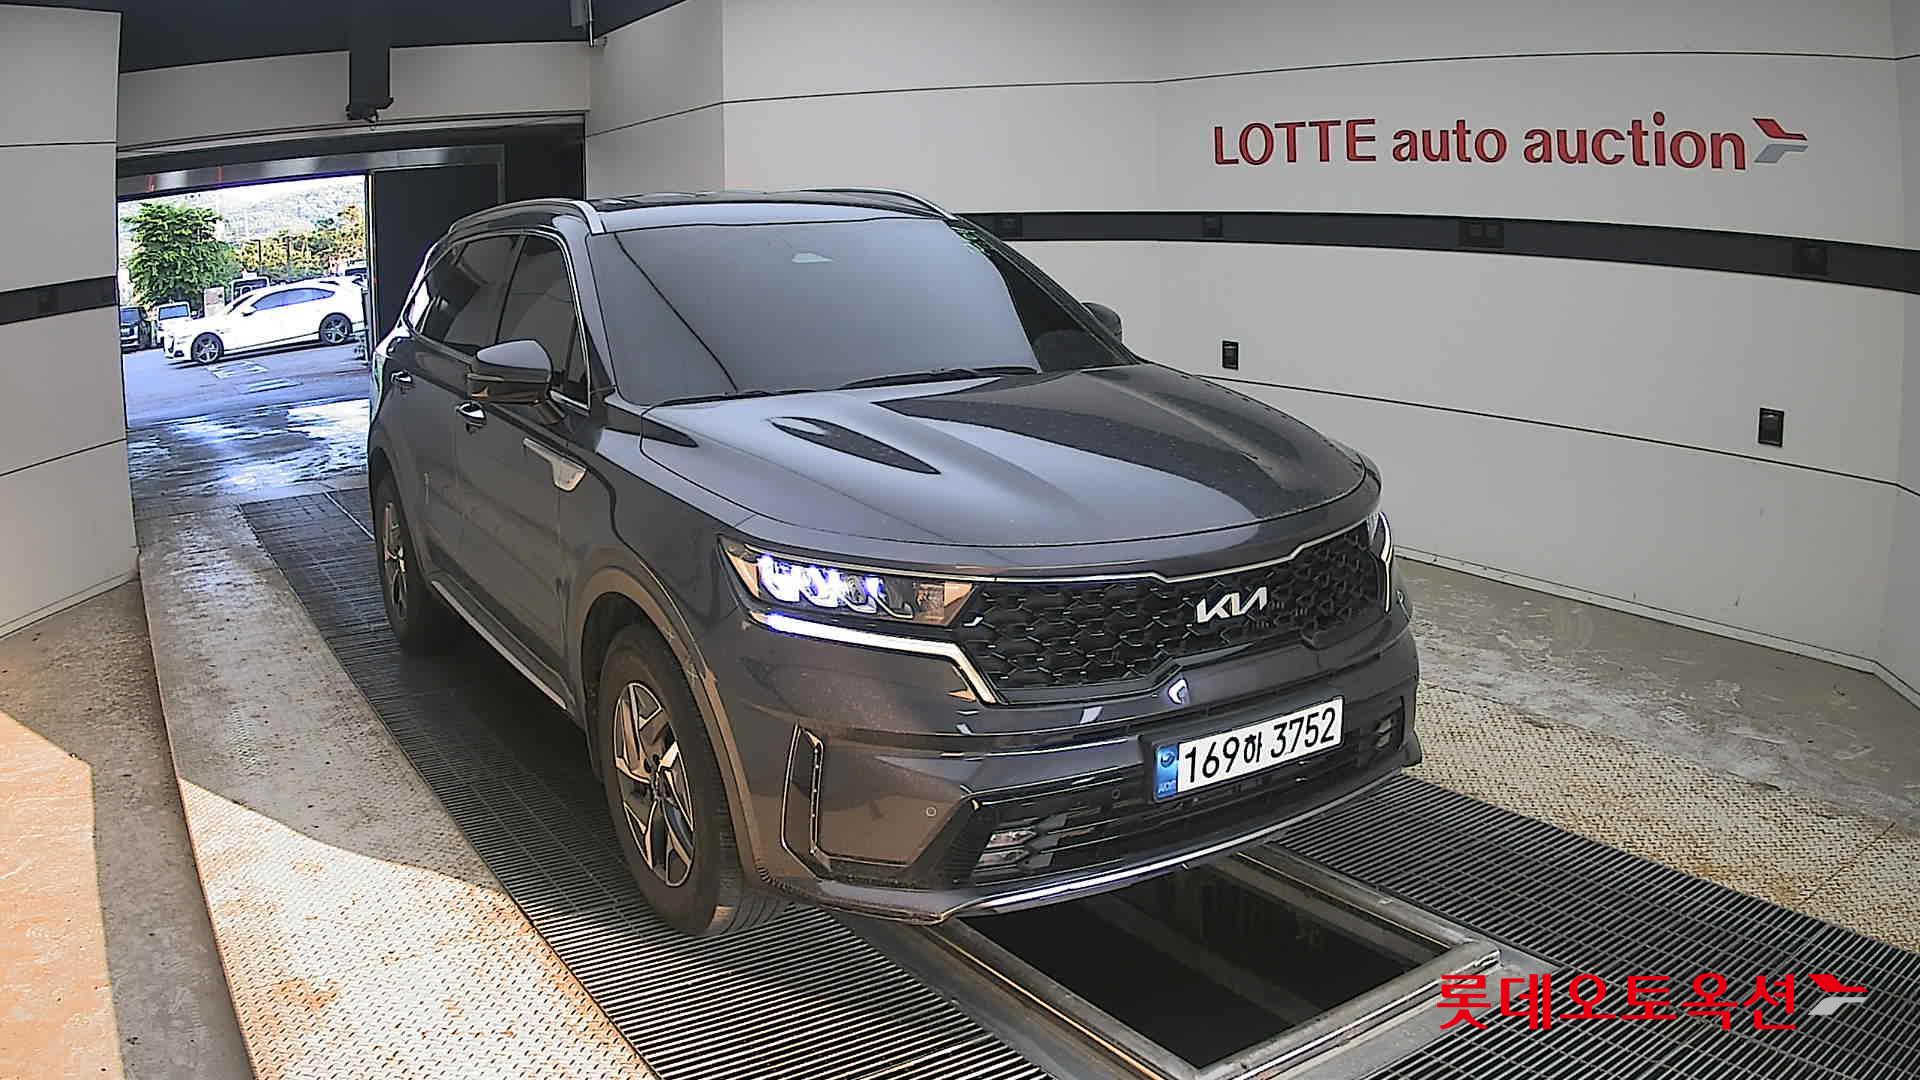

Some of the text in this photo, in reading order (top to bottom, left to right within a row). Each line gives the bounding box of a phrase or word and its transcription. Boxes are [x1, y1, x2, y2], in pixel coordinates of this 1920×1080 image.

[1214, 111, 1747, 170] LOTTE auto auction
[1196, 586, 1268, 623] KIA
[1185, 707, 1336, 783] 169하 3752
